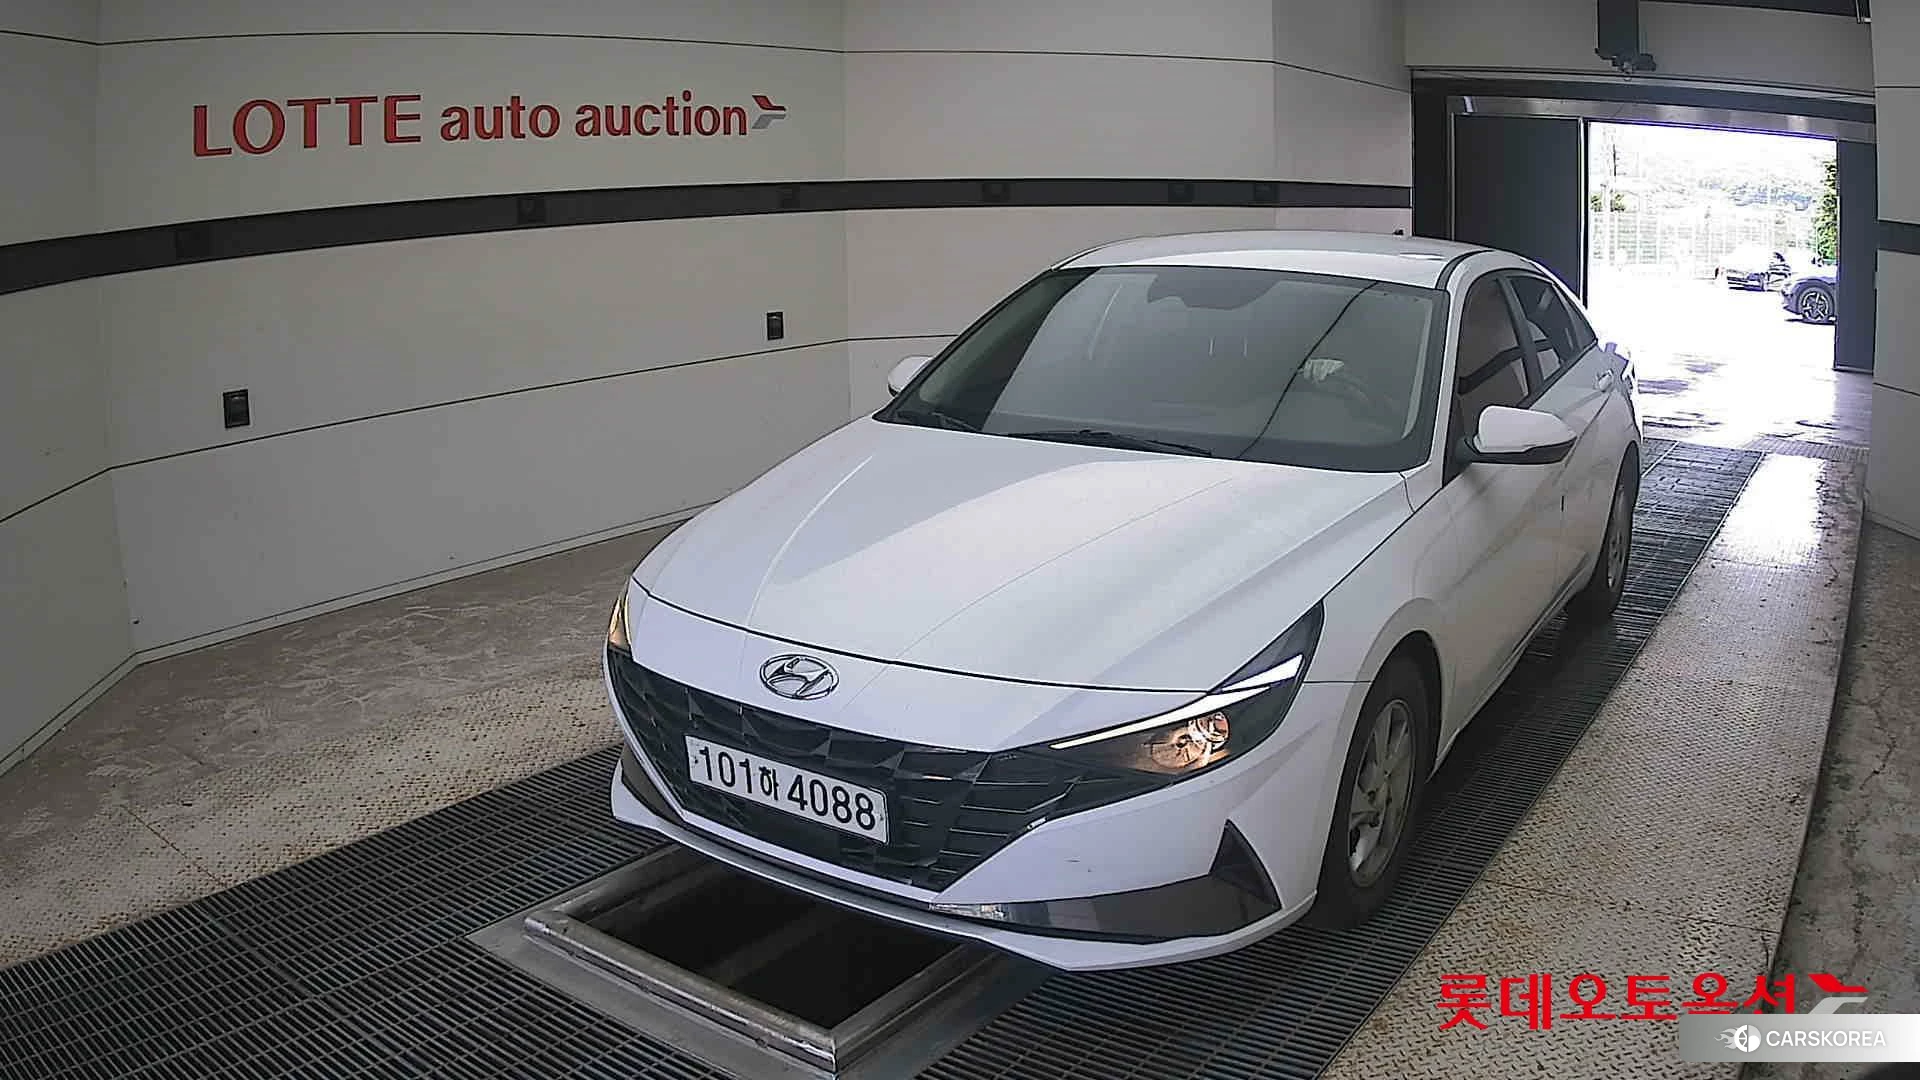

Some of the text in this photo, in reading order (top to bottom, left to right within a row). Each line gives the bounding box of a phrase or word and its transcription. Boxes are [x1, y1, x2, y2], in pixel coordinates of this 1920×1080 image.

[193, 91, 748, 157] LOTTE auto auction
[698, 746, 876, 830] 101하 4088
